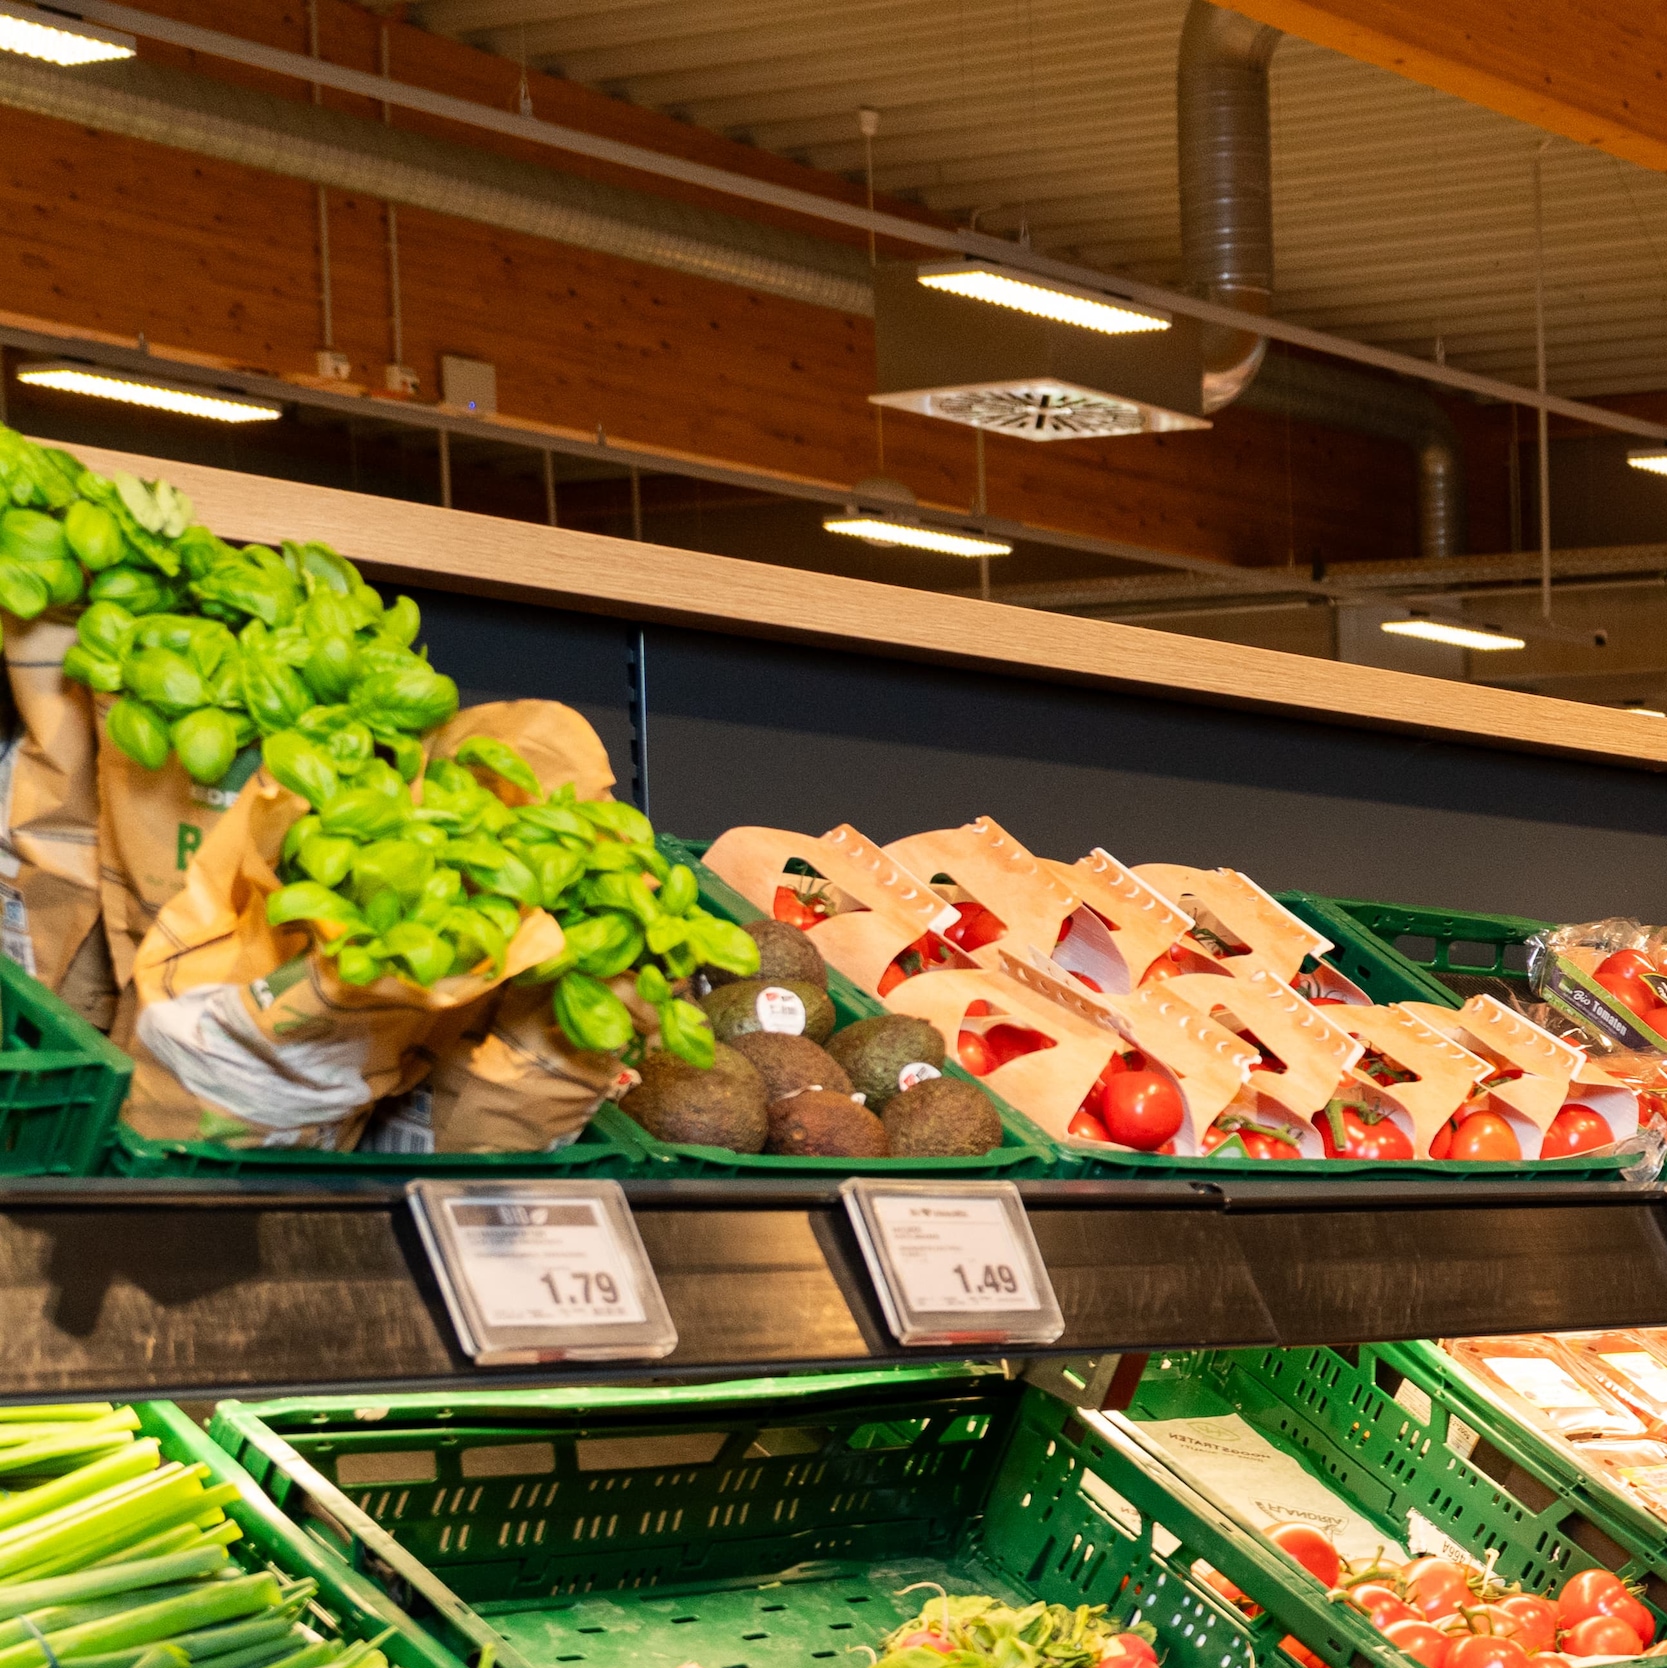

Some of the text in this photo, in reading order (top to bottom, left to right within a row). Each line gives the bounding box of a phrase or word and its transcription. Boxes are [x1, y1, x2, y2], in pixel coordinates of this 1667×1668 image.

[1592, 999, 1627, 1037] Tomaten
[539, 1271, 621, 1305] 1.79
[954, 1263, 1019, 1294] 1.49
